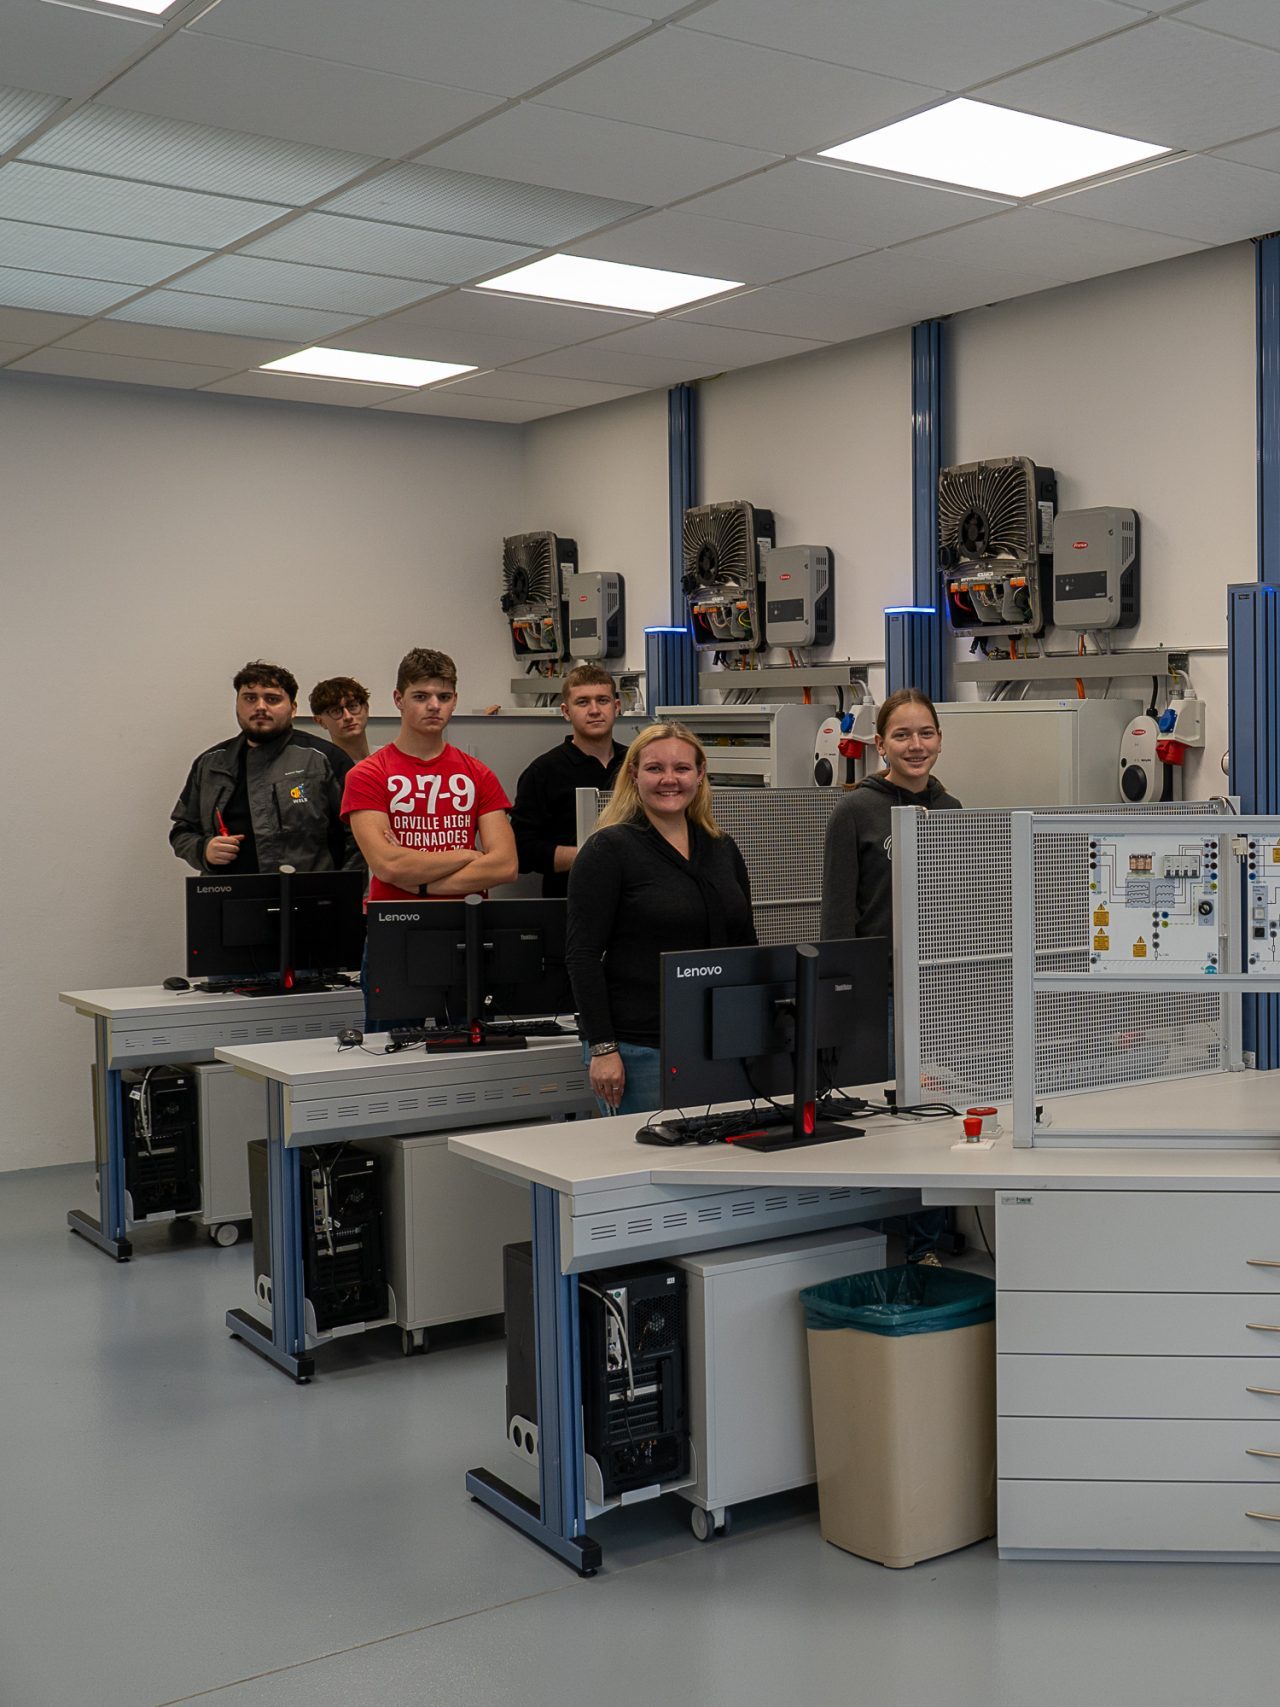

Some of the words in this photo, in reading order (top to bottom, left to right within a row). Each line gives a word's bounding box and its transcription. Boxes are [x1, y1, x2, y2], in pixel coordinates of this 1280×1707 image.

[387, 773, 475, 814] 2-7-9
[393, 815, 440, 830] ORVILLE
[443, 814, 471, 829] HIGH
[398, 830, 468, 847] TORNADOES
[196, 885, 232, 894] Lenovo
[378, 912, 420, 922] Lenovo
[676, 965, 723, 978] Lenovo
